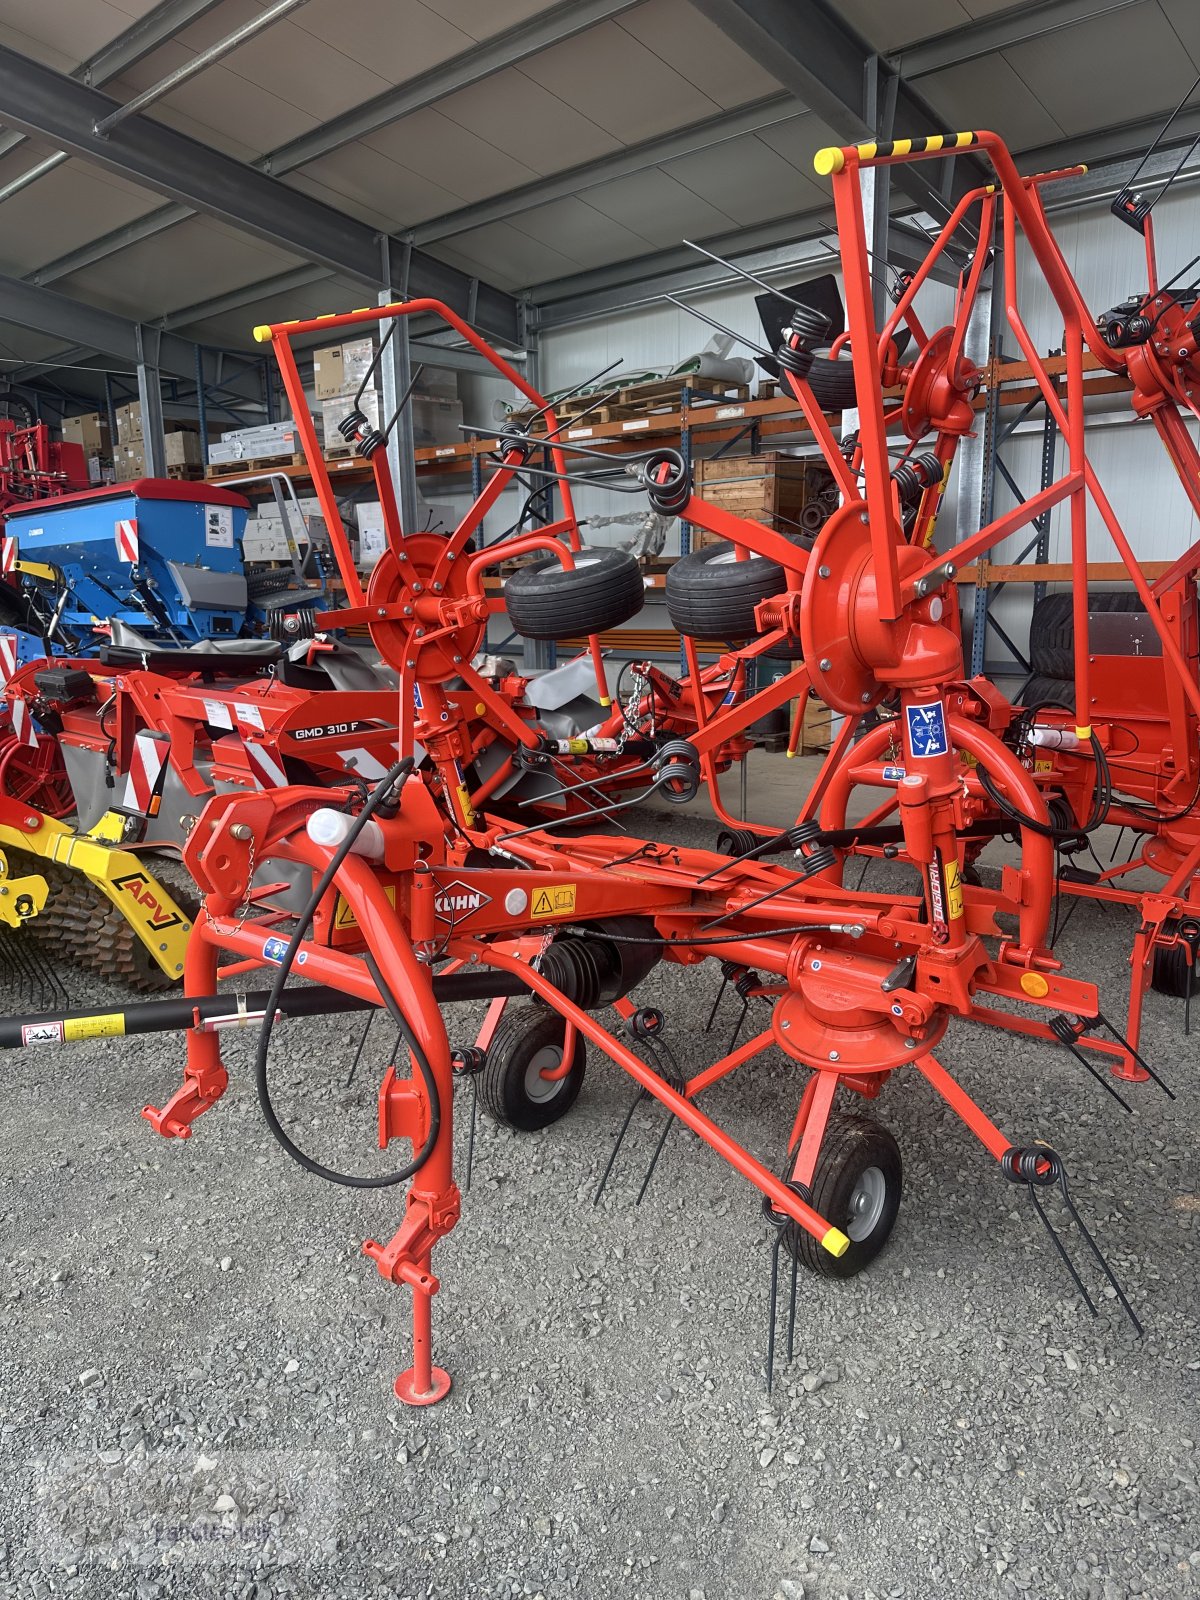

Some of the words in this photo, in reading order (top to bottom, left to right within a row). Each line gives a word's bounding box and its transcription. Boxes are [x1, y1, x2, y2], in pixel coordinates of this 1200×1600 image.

[295, 727, 323, 739] GMD
[327, 723, 348, 735] 310
[351, 722, 359, 731] F
[124, 880, 171, 923] APV
[435, 894, 480, 912] KUHN
